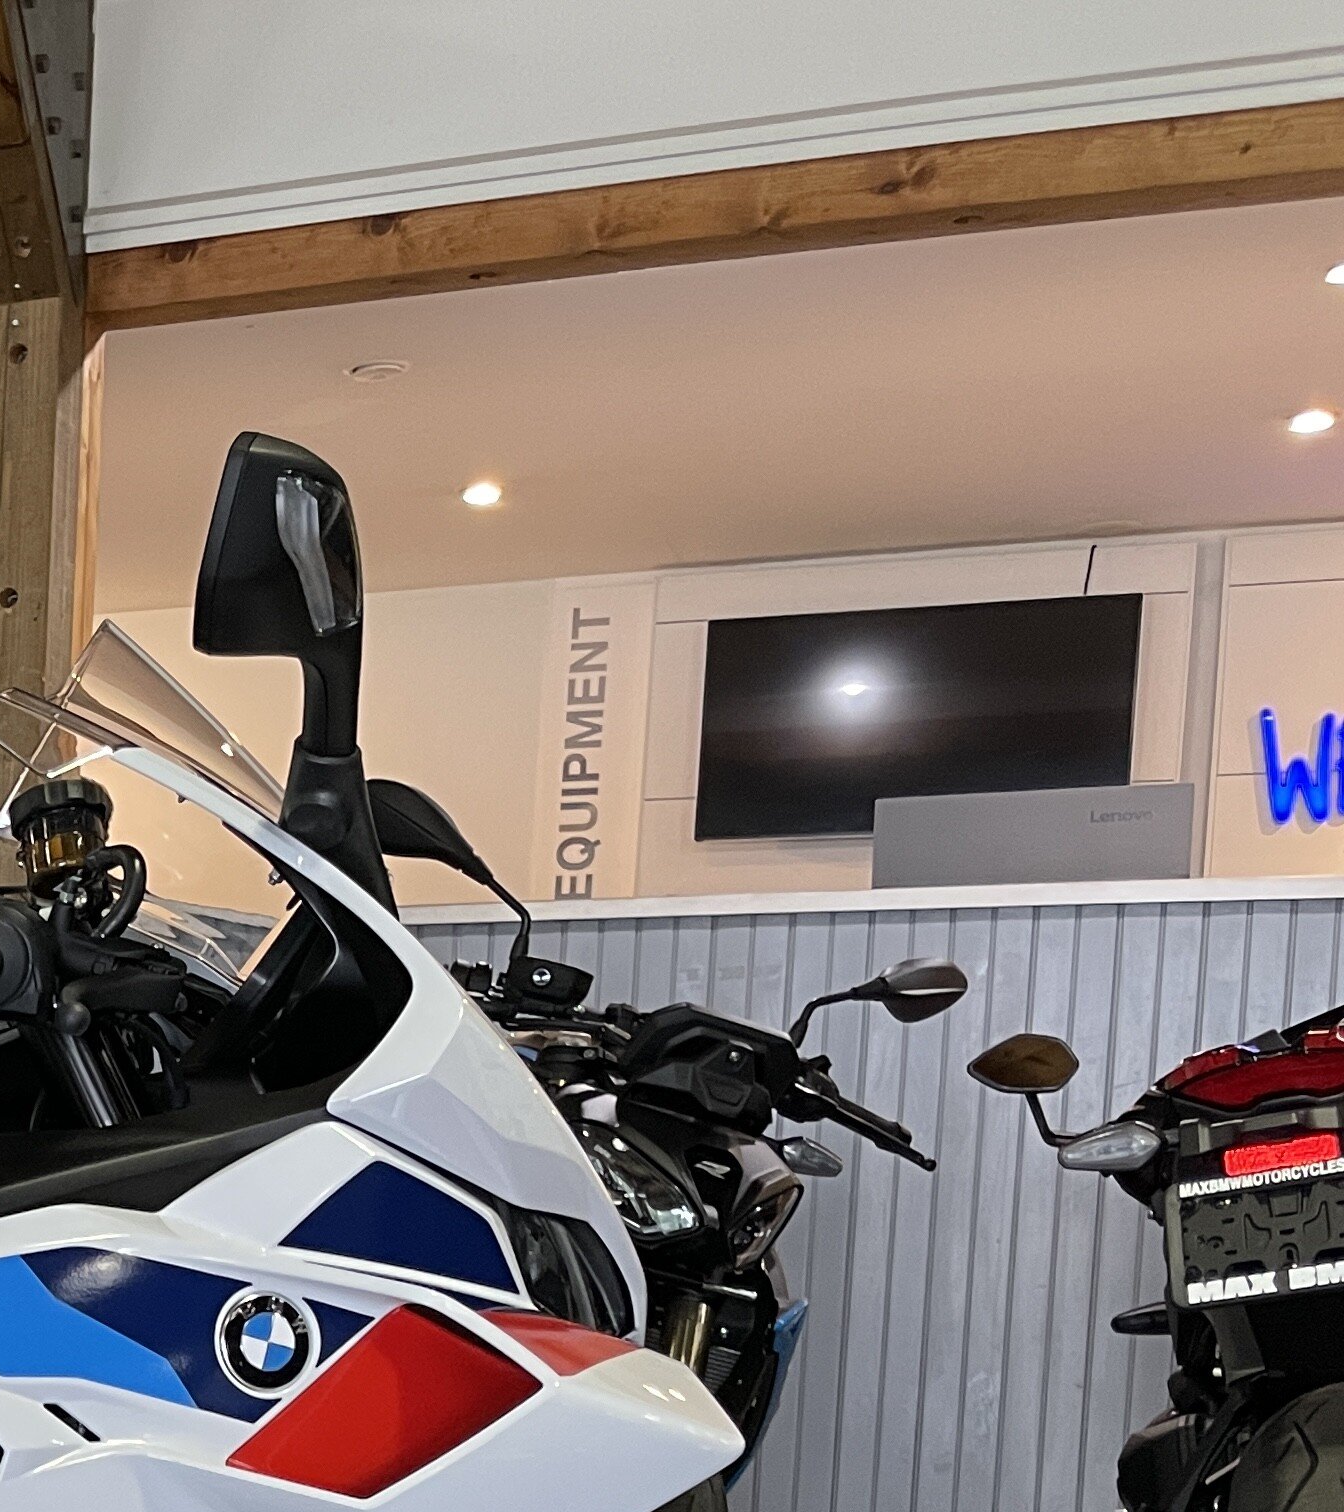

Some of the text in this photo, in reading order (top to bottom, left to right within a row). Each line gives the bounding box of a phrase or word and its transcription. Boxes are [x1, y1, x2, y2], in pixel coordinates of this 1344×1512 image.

[554, 607, 611, 900] EQUIPMENT
[1179, 1157, 1344, 1198] MAXBMWMOTORCYCLES
[1187, 1271, 1278, 1305] MAX
